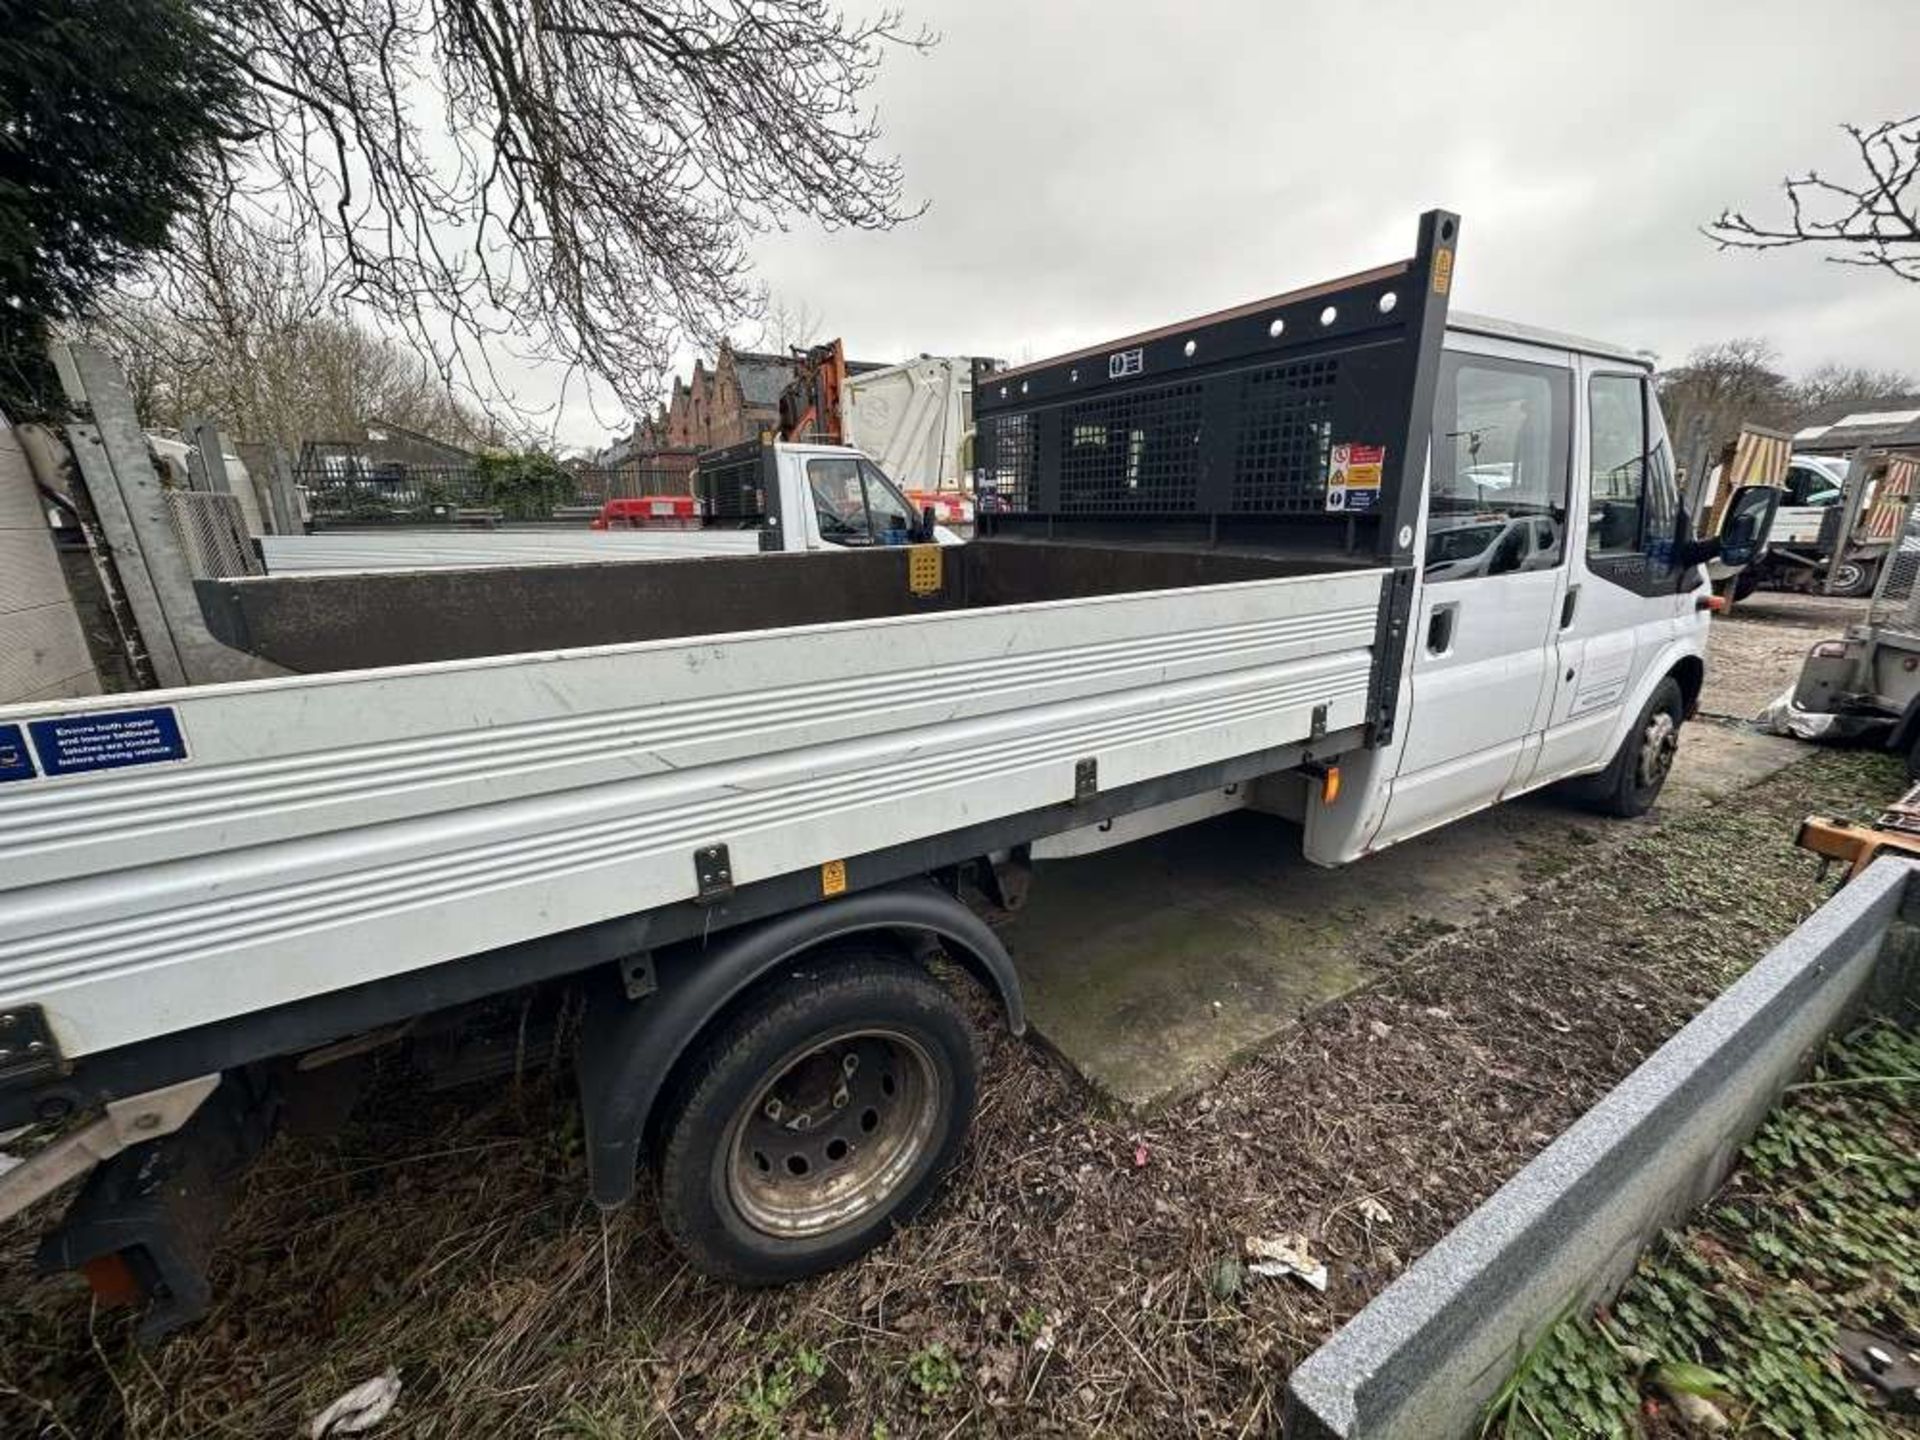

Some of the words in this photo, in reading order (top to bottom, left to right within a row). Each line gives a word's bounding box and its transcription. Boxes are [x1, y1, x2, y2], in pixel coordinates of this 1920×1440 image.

[55, 724, 95, 736] Ensure
[97, 720, 122, 732] both
[124, 719, 154, 730] upper
[58, 736, 79, 747] and
[80, 733, 111, 745] lower
[105, 741, 123, 751] are
[125, 737, 160, 748] locked
[58, 755, 94, 766] before
[97, 750, 133, 763] driving
[135, 746, 170, 757] vehicle
